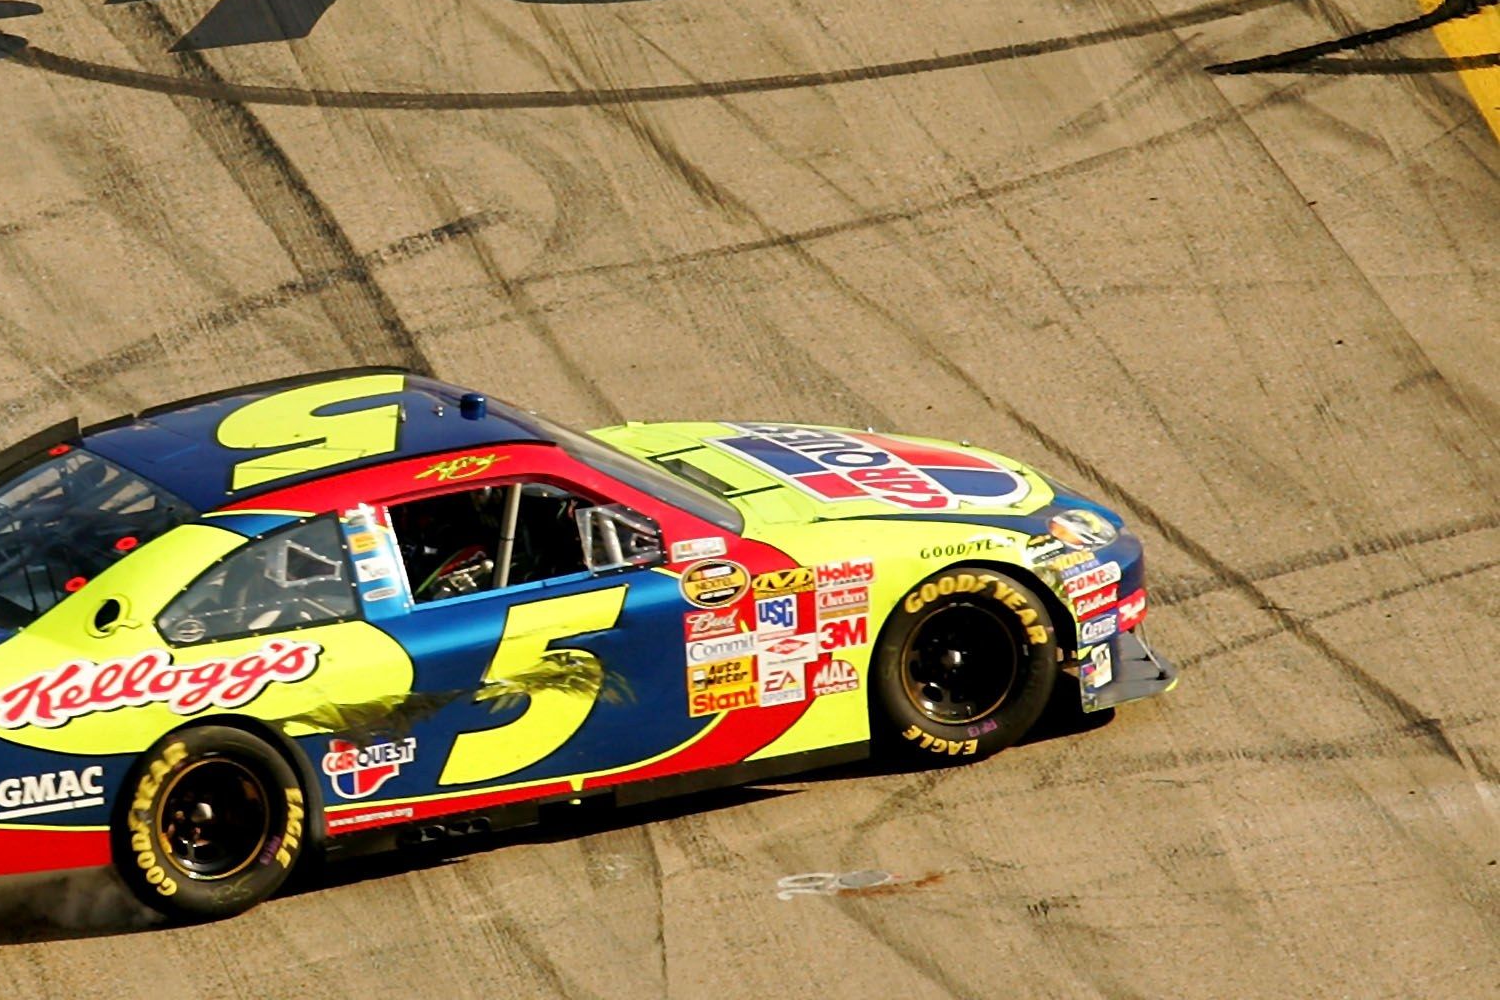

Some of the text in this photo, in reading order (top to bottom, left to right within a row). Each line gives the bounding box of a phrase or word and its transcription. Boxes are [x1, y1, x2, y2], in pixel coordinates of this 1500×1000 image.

[217, 374, 405, 490] 5
[817, 561, 873, 583] Holley
[687, 609, 738, 632] Bud
[758, 597, 794, 627] USG
[904, 574, 1048, 645] GOODYEAR
[689, 635, 754, 661] Commit
[820, 617, 867, 650] 3M
[0, 641, 311, 723] Kellogg's
[708, 661, 741, 674] Auto
[765, 671, 796, 692] EA
[813, 660, 858, 687] MAC
[438, 584, 628, 785] 5
[693, 686, 757, 714] Stant
[324, 738, 415, 773] CARQUEST
[902, 724, 978, 756] EAGLE
[127, 742, 188, 896] GOODYEAR
[275, 788, 304, 868] EAGLE
